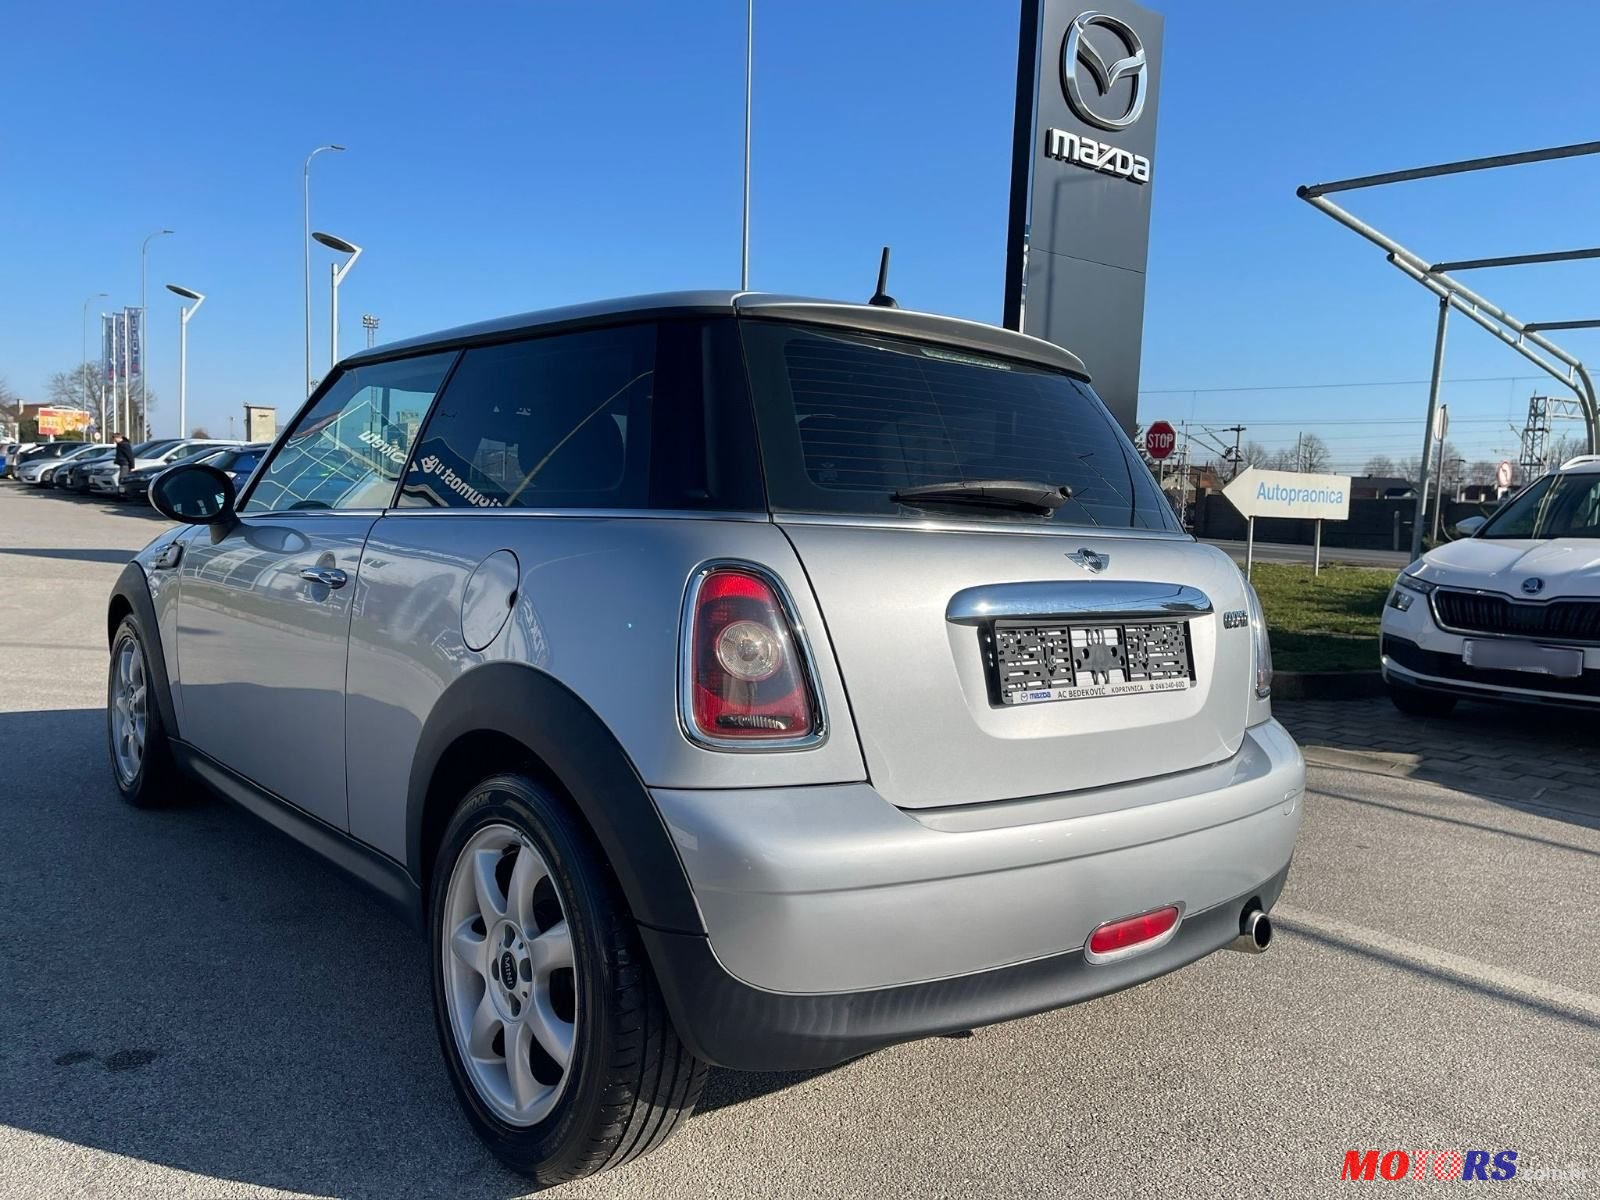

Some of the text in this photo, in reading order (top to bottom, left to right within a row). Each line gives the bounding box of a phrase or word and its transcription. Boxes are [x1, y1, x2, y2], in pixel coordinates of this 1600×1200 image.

[1148, 433, 1174, 448] STOP
[1257, 482, 1344, 506] Autopraonica
[1058, 690, 1067, 699] AC
[1068, 686, 1106, 698] BEDEKOVIĆ
[1111, 685, 1144, 694] KOPRIVNICA
[504, 955, 513, 985] MINI
